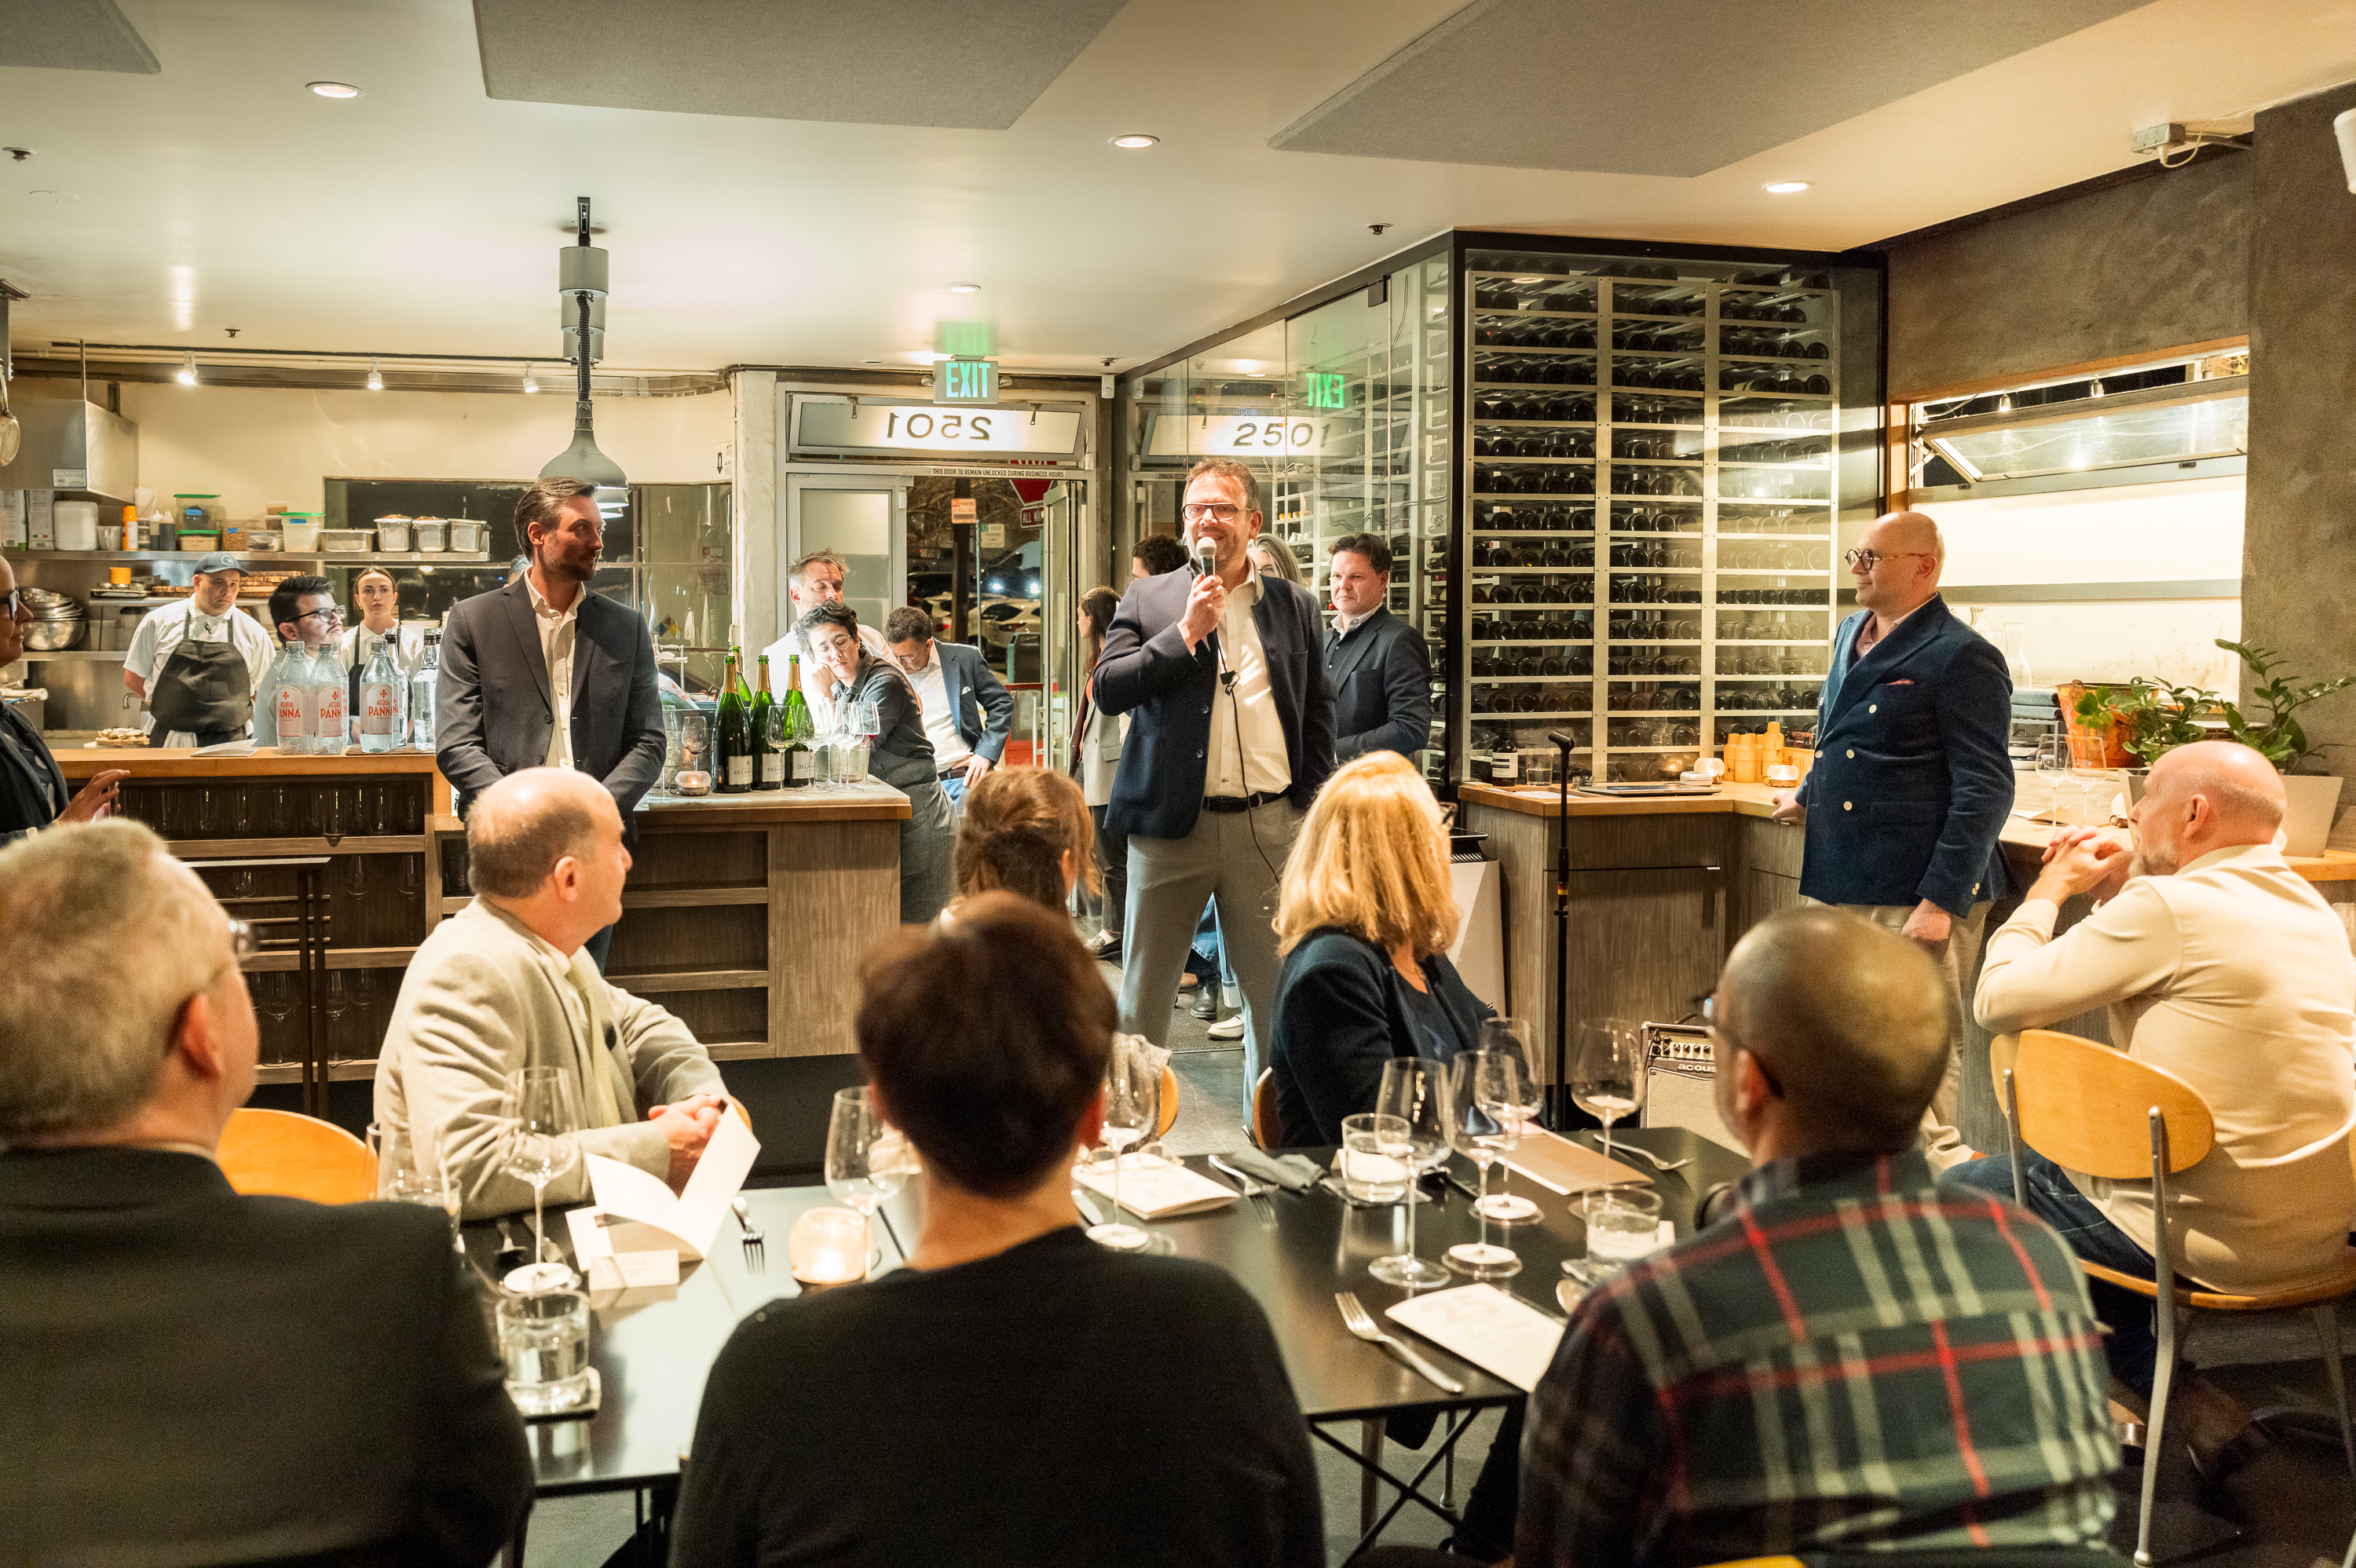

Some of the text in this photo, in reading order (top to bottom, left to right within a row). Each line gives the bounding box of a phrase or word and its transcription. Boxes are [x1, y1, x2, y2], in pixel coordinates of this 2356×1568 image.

[946, 362, 991, 398] EXIT
[1233, 422, 1331, 448] 2501
[1023, 510, 1044, 524] ALL WA
[278, 707, 301, 718] ANNA
[320, 707, 342, 719] PANN
[1677, 1064, 1717, 1073] acous
